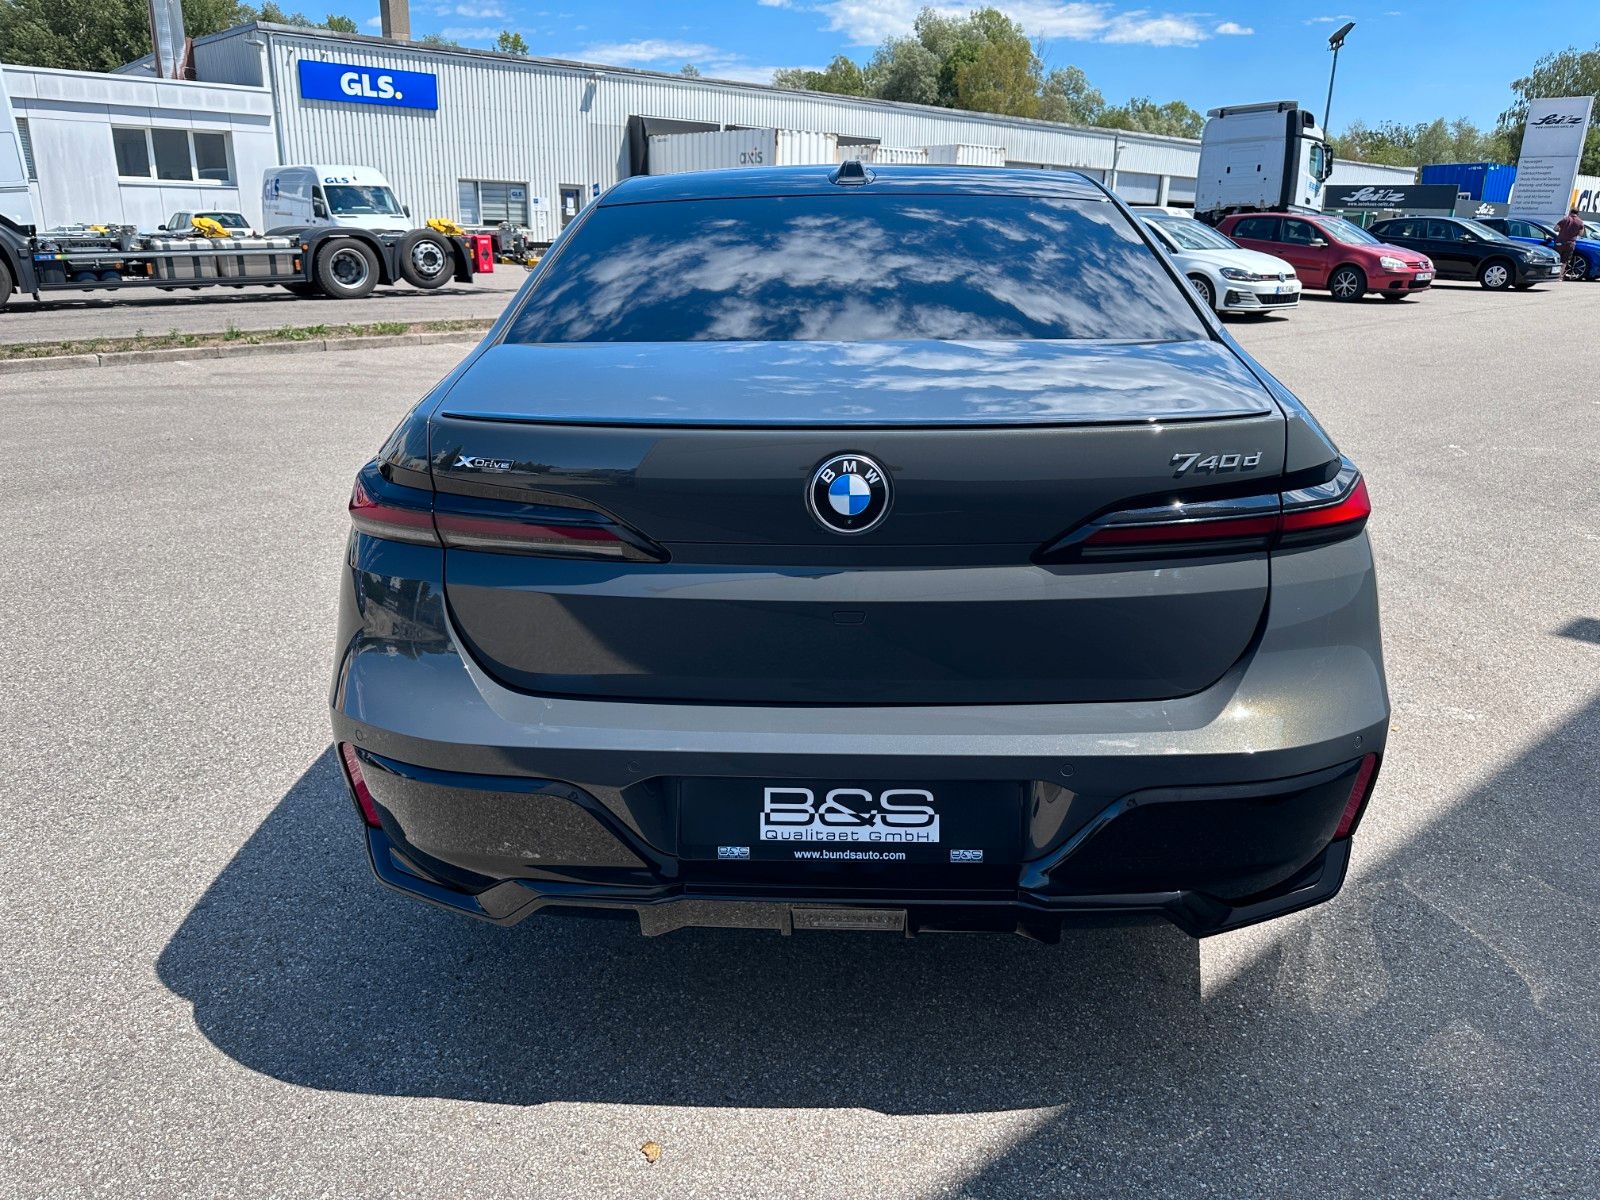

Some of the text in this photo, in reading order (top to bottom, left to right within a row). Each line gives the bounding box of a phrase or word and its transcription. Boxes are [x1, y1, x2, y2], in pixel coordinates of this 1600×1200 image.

[739, 147, 763, 165] axis
[324, 176, 350, 184] GLS
[1341, 186, 1405, 202] Seitz
[1170, 451, 1263, 473] 740d
[820, 460, 881, 485] BMW
[764, 787, 936, 828] B&S
[765, 829, 860, 841] Qualitaet
[718, 846, 750, 856] B&S
[793, 849, 906, 861] www.bundsauto.com
[950, 849, 983, 860] B&S
